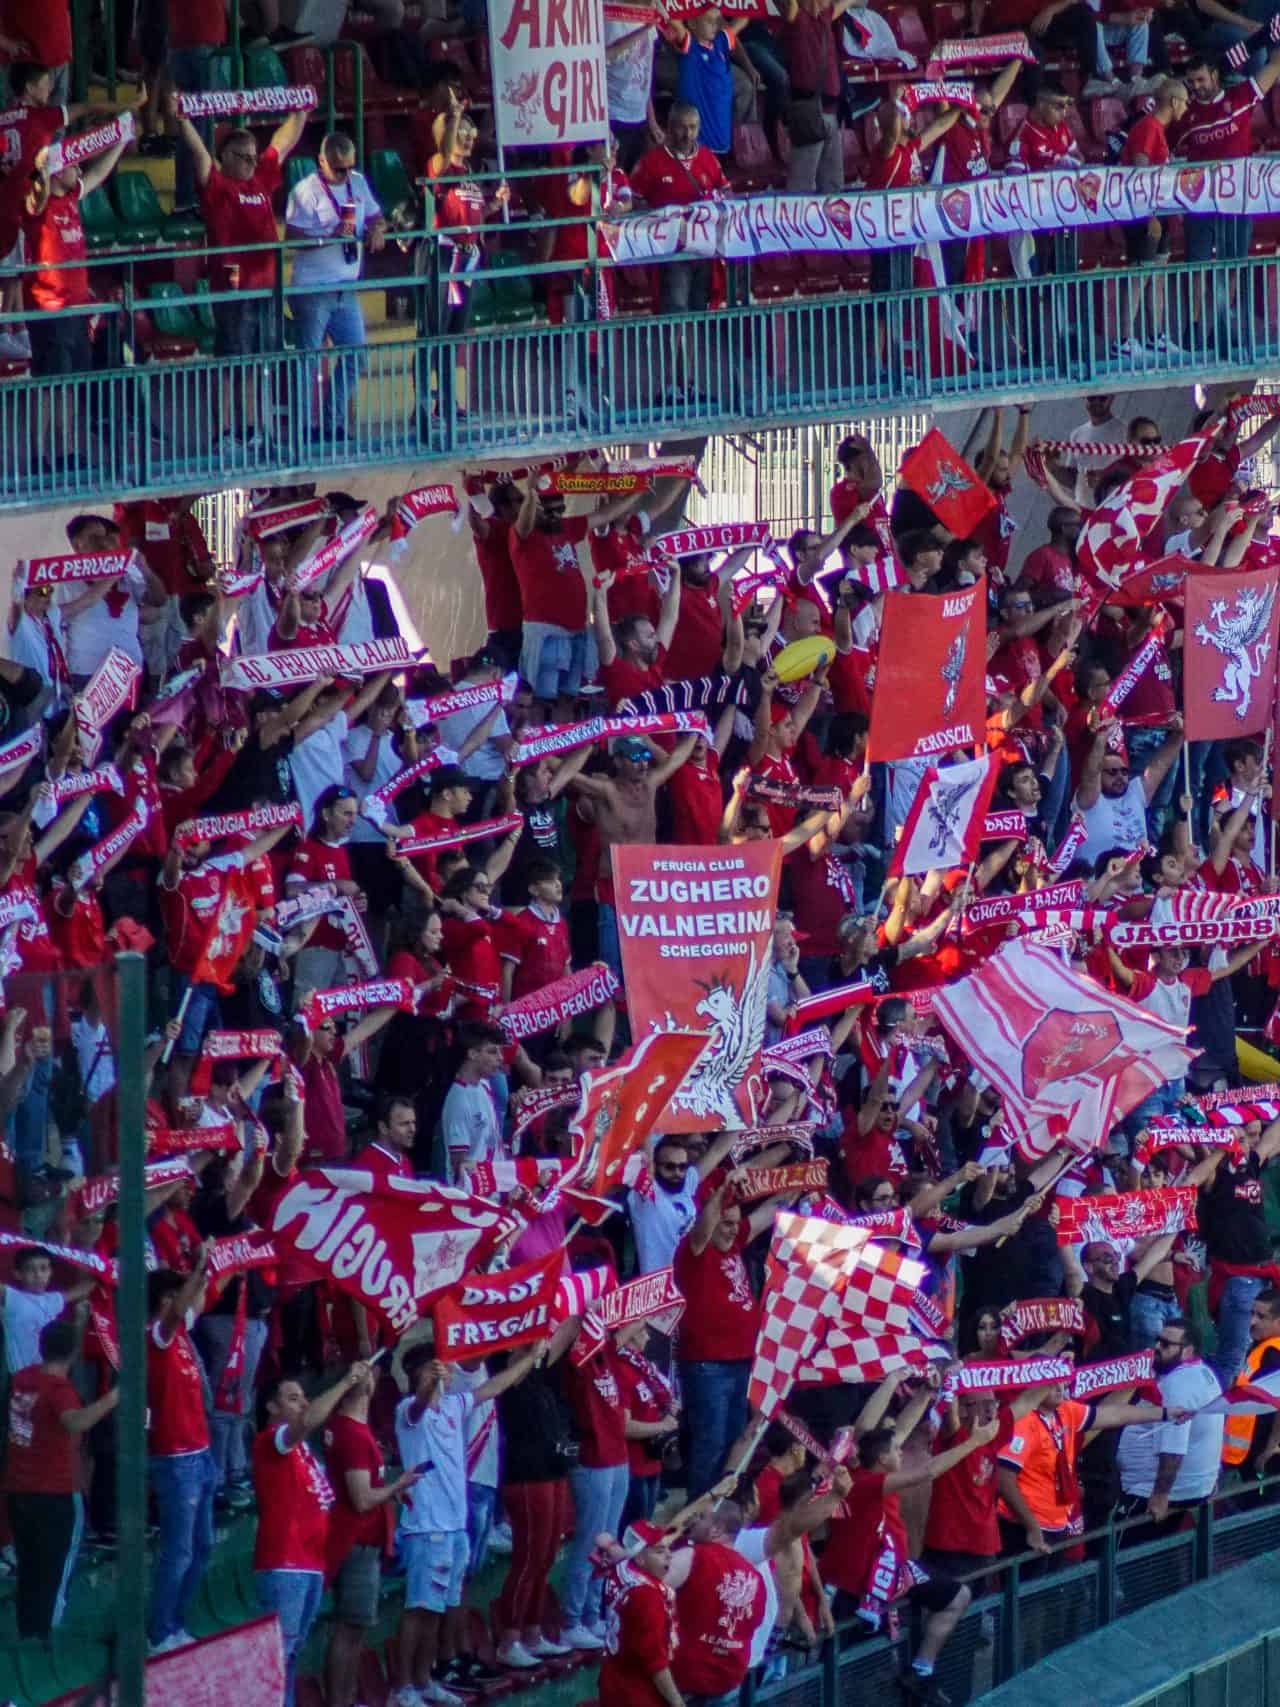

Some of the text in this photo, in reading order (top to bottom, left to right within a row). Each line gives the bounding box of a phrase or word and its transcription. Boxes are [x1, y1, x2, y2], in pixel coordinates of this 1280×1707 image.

[1195, 122, 1239, 144] TOYOTA
[985, 178, 1077, 222] NATO
[1105, 173, 1164, 209] DAL
[659, 526, 765, 553] PERUGIA
[34, 553, 126, 582] AC PERUGIA
[238, 636, 410, 684] AC PERUGIA CALCIO
[653, 858, 745, 873] PERUGIA CLUB
[630, 876, 771, 903] ZUGHERO
[621, 910, 771, 937] VALNERINA
[1117, 918, 1273, 944] JACOBINS
[659, 942, 748, 958] SCHEGGINO
[500, 970, 619, 1041] PERUGIA PERUGIA
[447, 1304, 548, 1347] FREGHI
